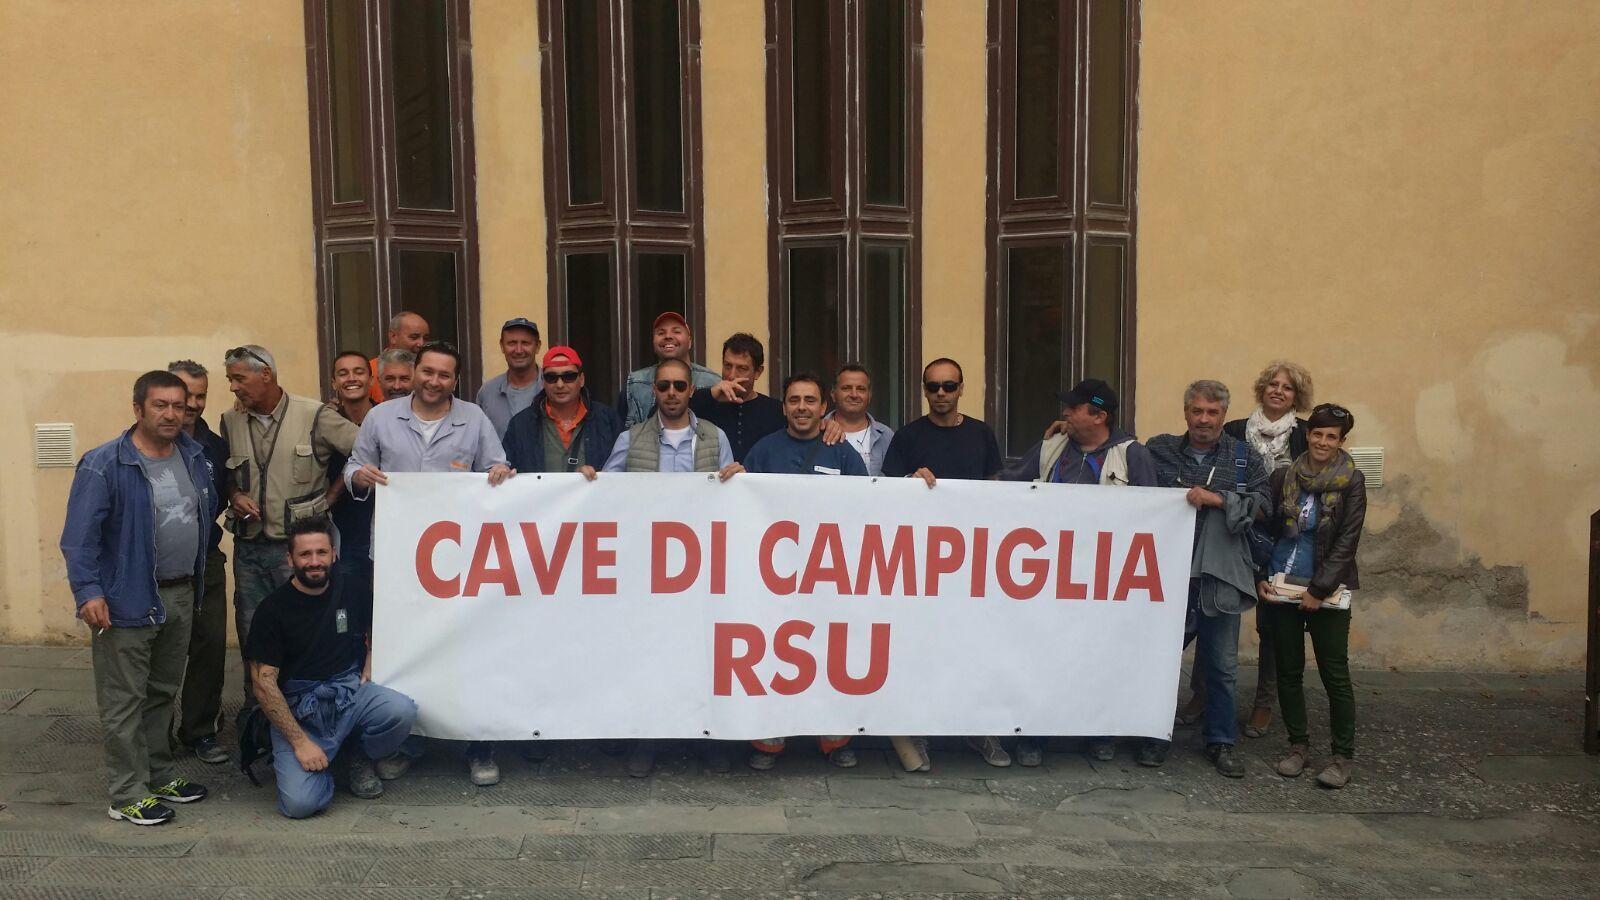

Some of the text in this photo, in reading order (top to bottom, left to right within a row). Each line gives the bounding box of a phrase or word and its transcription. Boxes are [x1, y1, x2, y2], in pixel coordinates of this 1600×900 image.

[414, 519, 1165, 602] CAVE DI CAMPIGLIA
[712, 619, 891, 697] RSU
